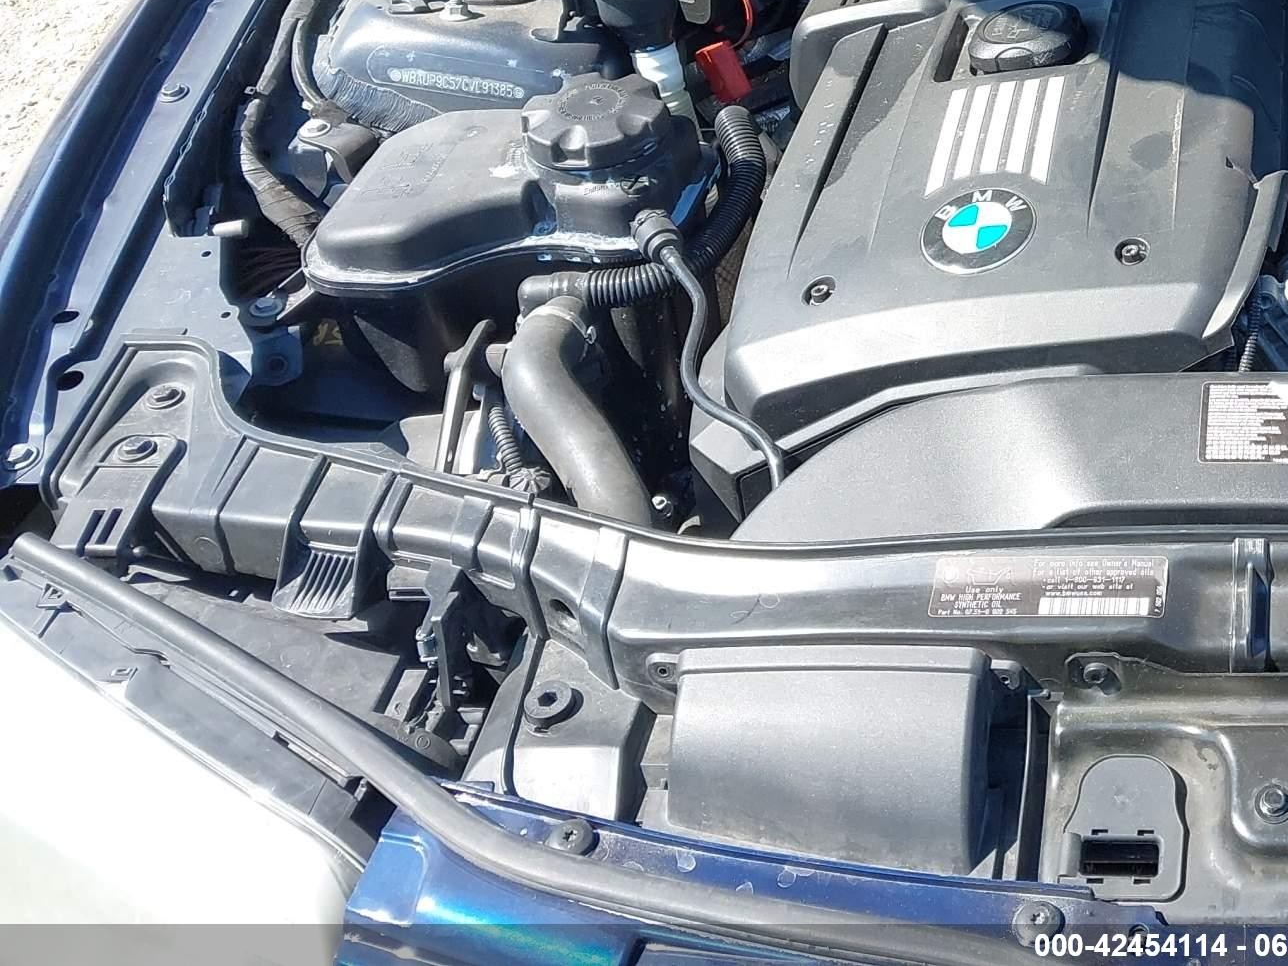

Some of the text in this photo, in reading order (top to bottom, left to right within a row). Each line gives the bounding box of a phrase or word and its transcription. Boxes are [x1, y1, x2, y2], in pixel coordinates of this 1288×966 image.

[935, 190, 1028, 221] BMW
[1131, 559, 1154, 567] Manual
[985, 586, 1004, 594] only
[977, 593, 1022, 601] PERFORMANCE
